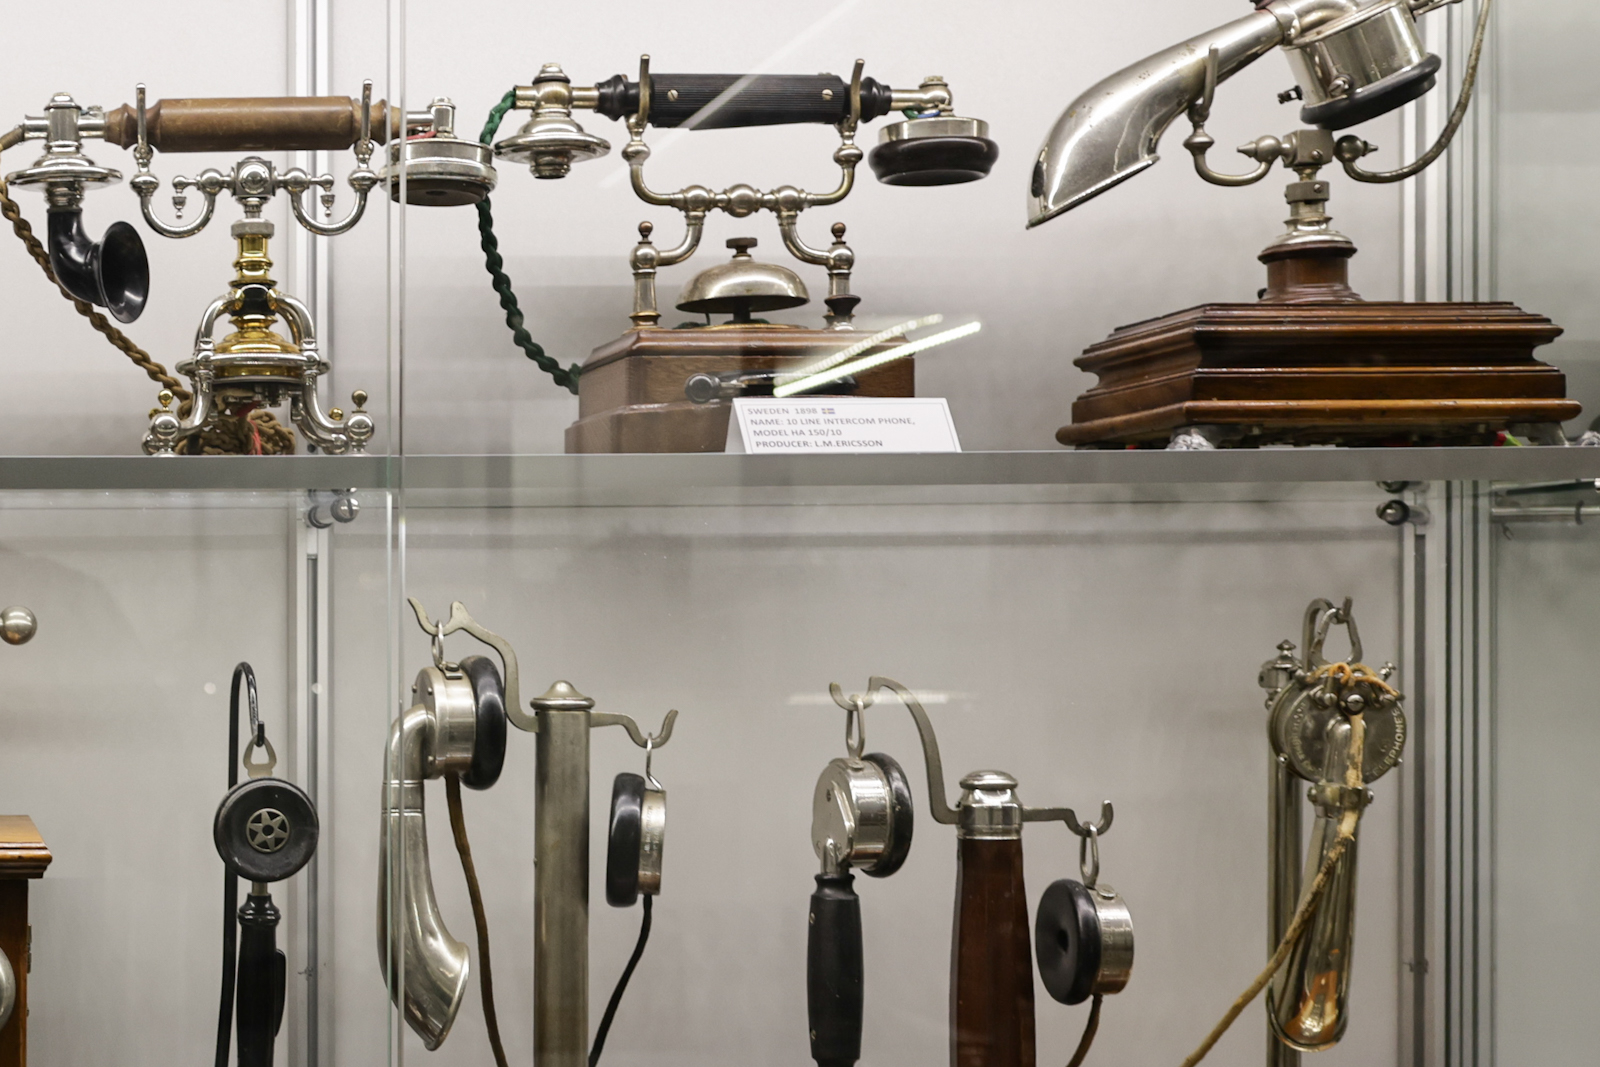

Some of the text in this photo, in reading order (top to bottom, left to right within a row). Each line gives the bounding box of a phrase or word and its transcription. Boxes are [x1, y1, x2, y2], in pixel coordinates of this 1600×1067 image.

[795, 407, 818, 415] 1898
[878, 418, 916, 426] PHONE,
[753, 429, 789, 437] MODEL
[809, 428, 842, 436] 150/10
[755, 440, 883, 448] PRODUCER: L.M.ERICSSON
